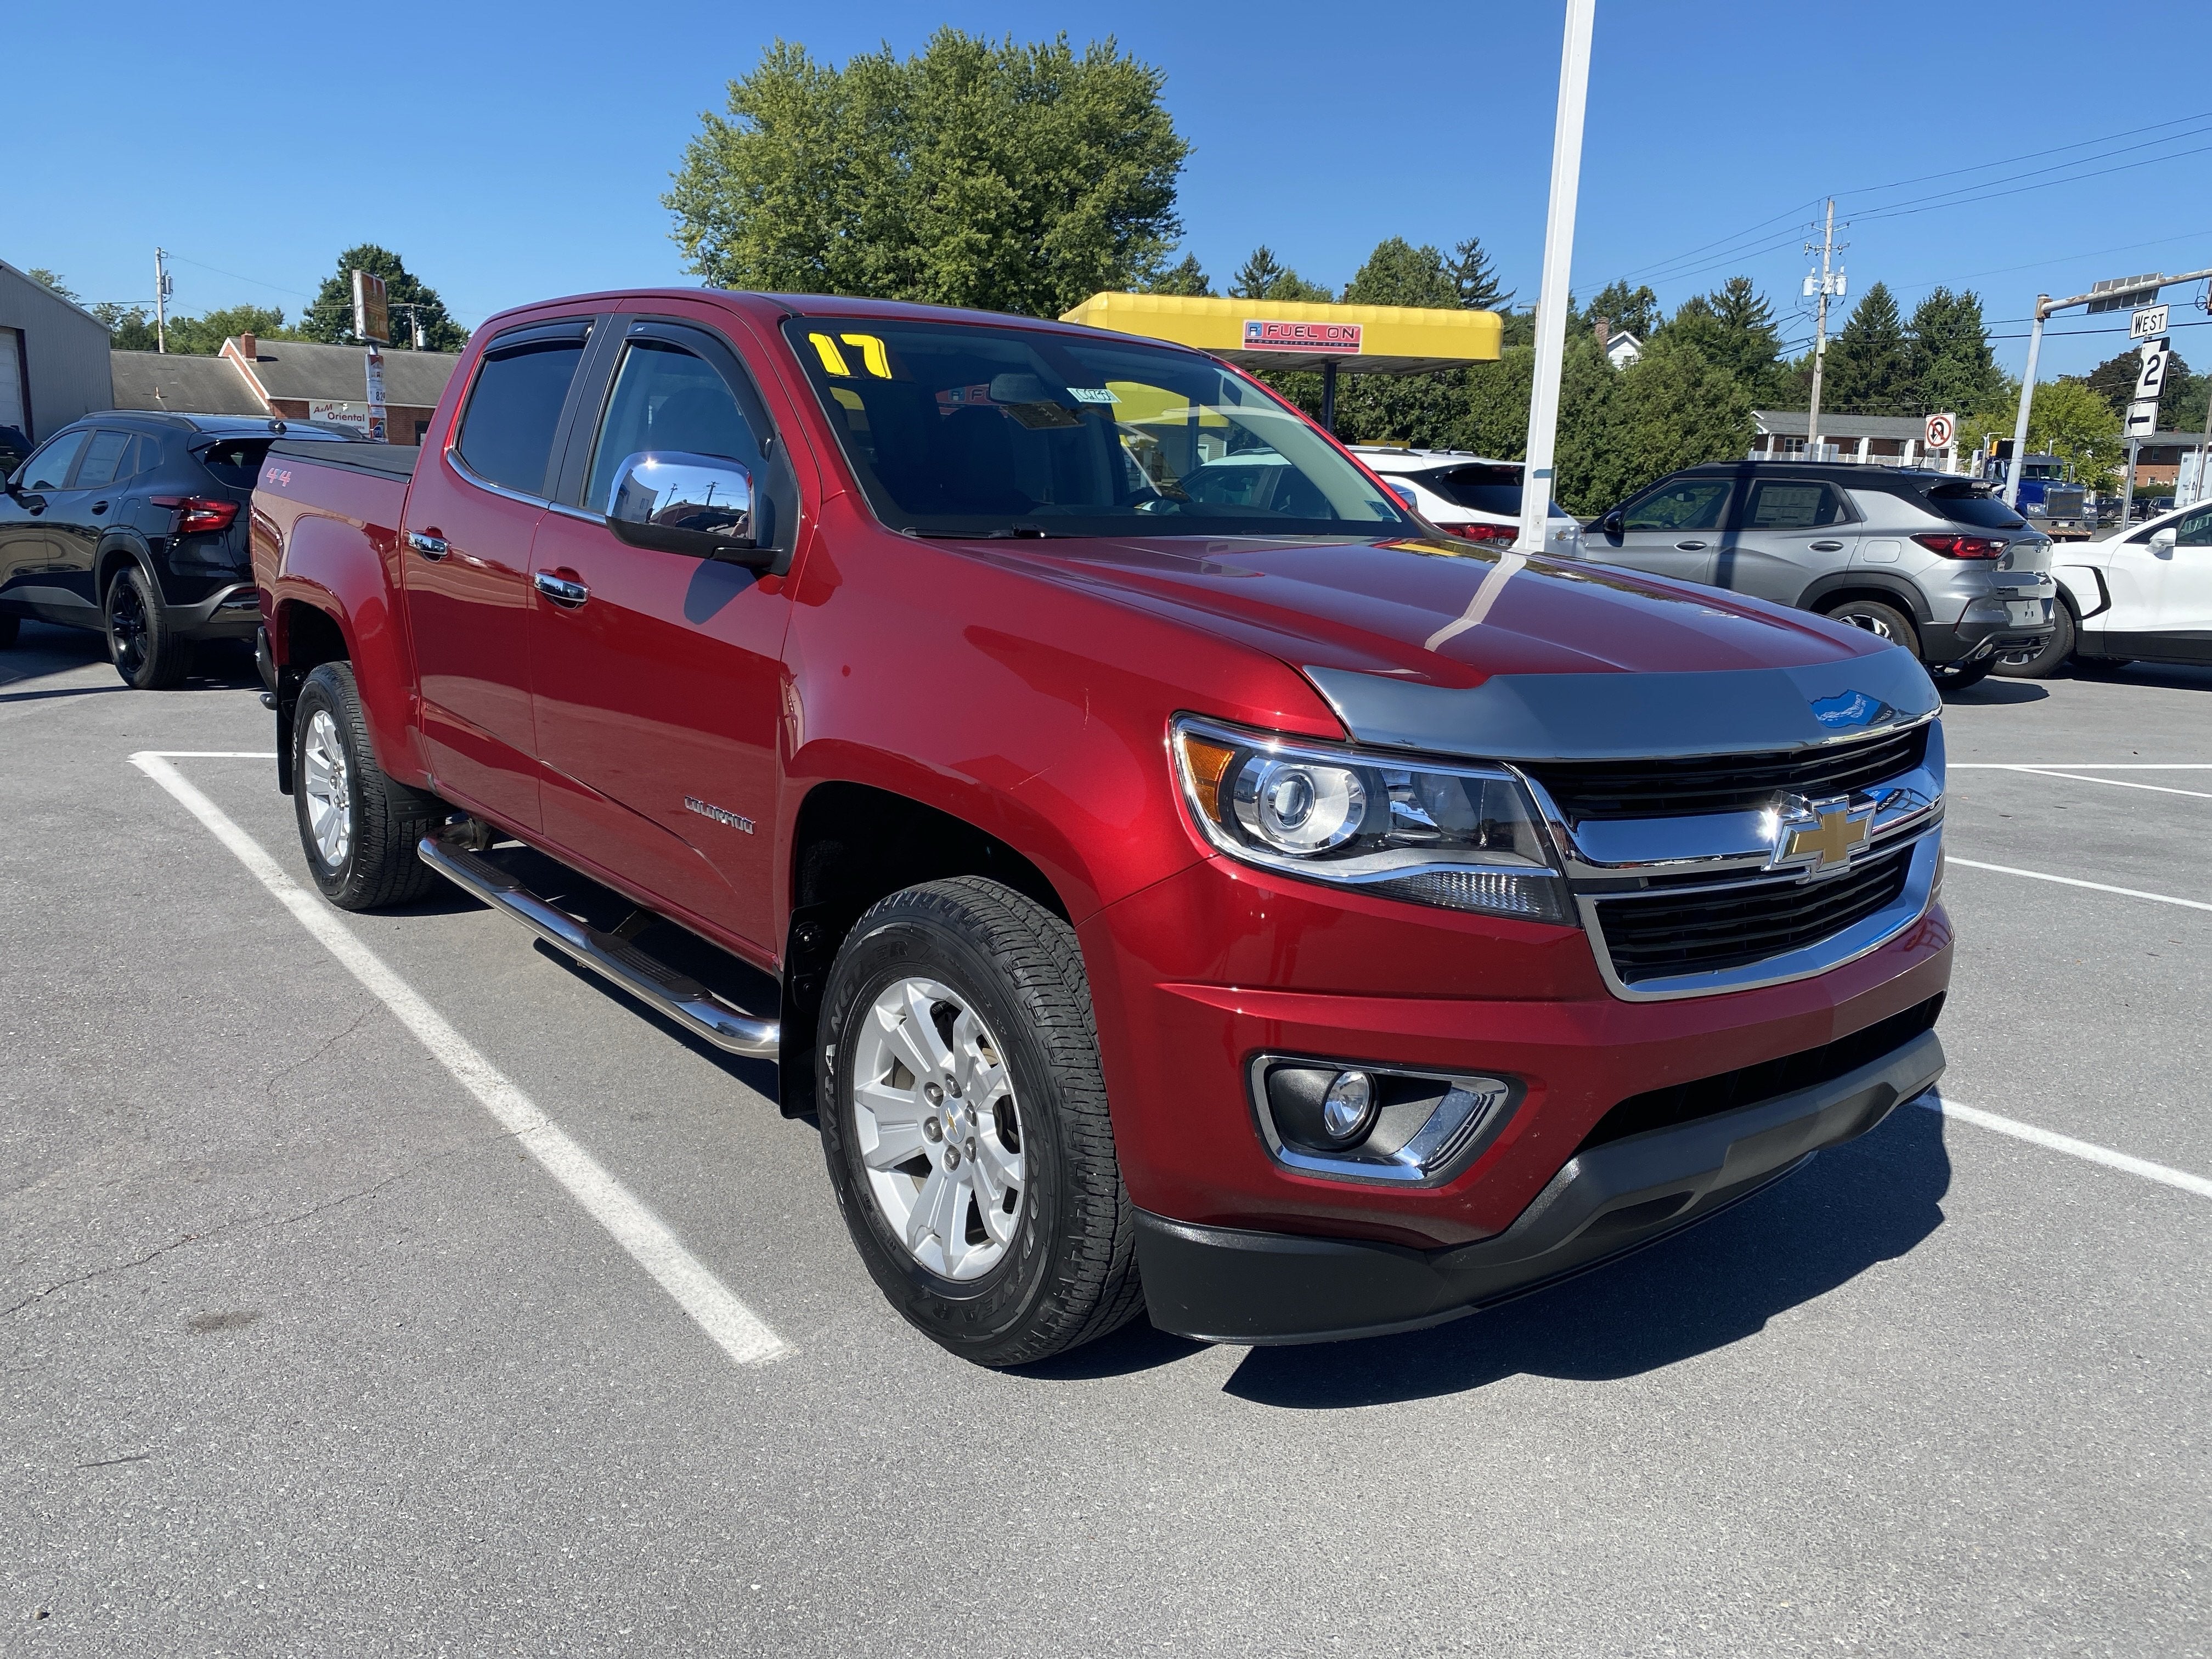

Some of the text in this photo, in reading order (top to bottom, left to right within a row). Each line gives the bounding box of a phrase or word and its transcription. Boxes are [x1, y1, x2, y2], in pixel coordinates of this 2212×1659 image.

[1267, 325, 1355, 339] FUEL ON
[2135, 313, 2164, 334] WEST
[809, 332, 892, 379] 17
[313, 403, 332, 414] A&M
[328, 412, 365, 422] Oriental
[684, 795, 755, 835] COLORADO
[825, 939, 910, 1152] WRANGLER
[932, 1091, 1041, 1324] GOODYEAR
